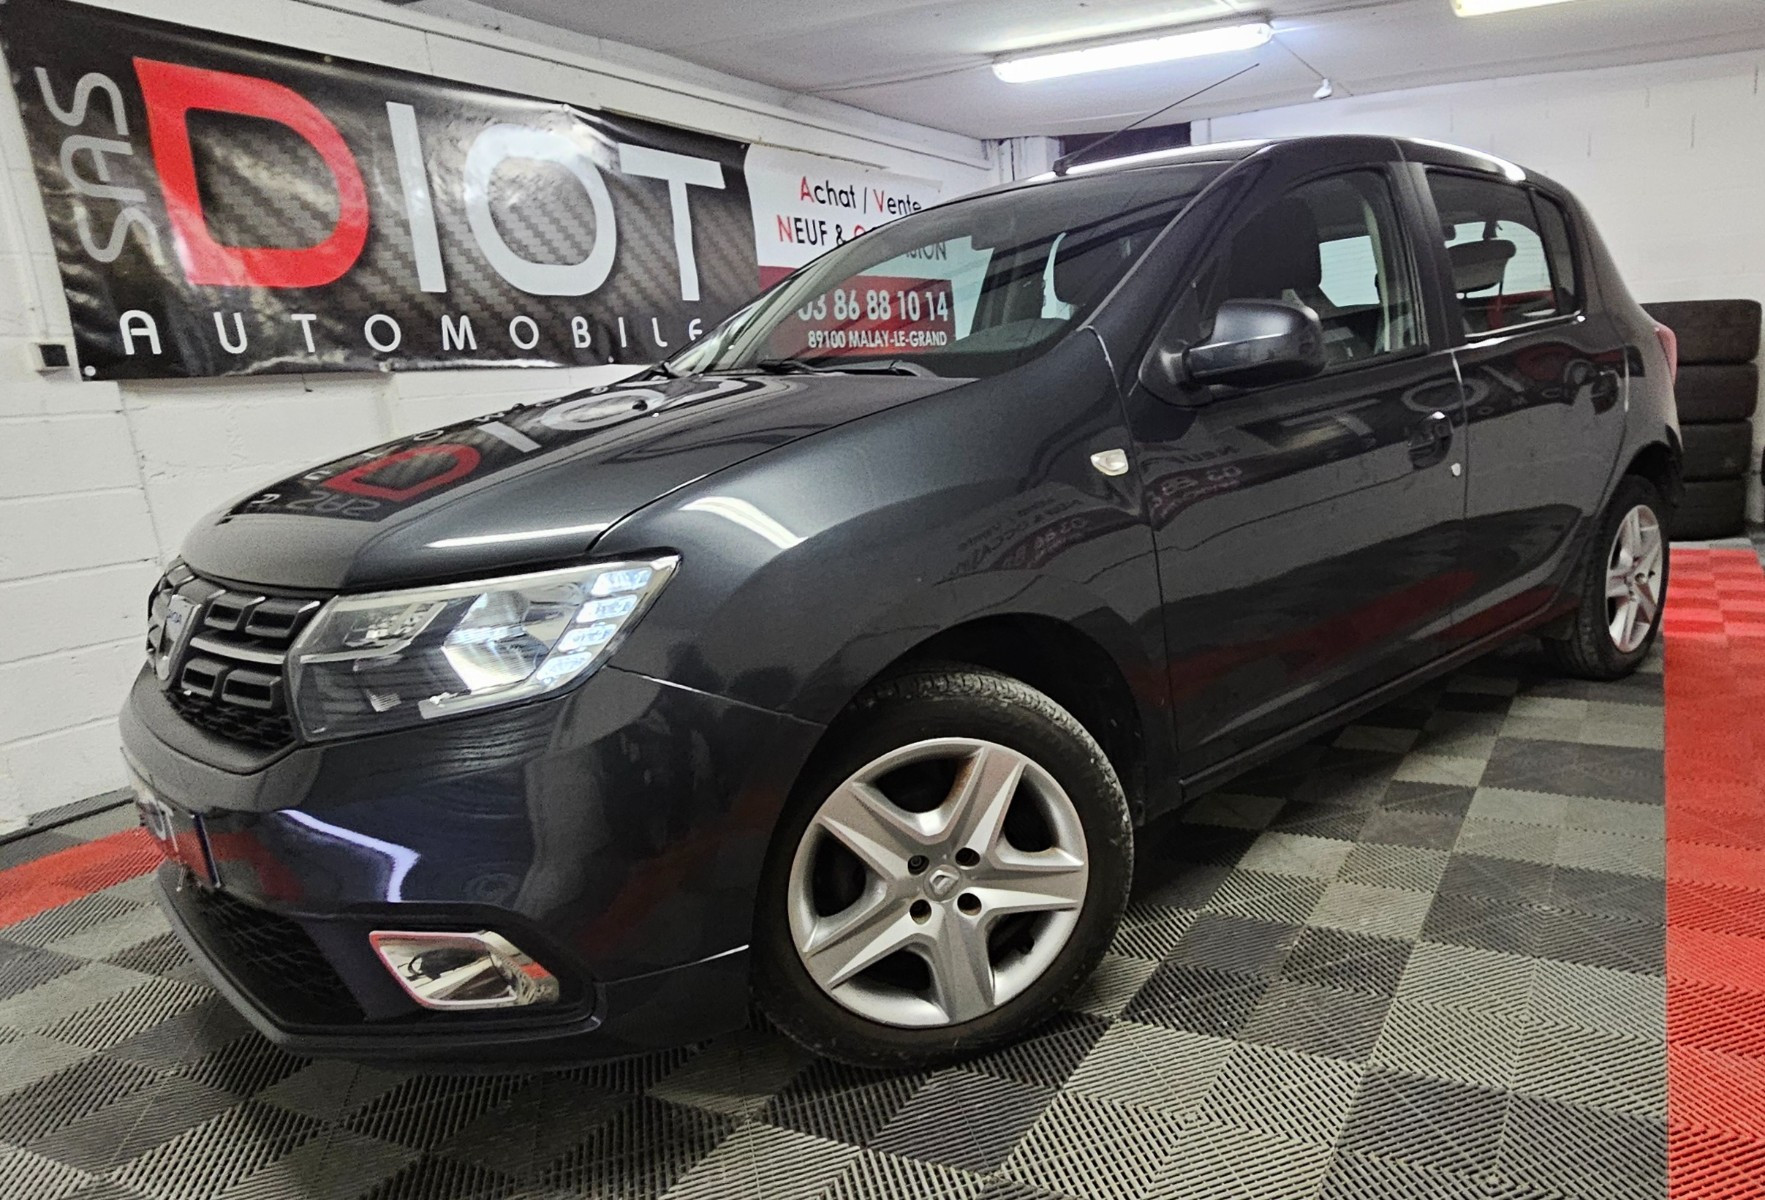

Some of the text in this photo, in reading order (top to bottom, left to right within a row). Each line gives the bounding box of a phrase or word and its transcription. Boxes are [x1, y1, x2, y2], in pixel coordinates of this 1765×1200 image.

[34, 66, 165, 266] SAS
[132, 56, 726, 301] DIOT
[800, 175, 857, 209] Achat
[777, 214, 828, 246] NEUF
[834, 288, 860, 321] 86
[866, 289, 892, 321] 88
[897, 290, 921, 321] 10
[925, 290, 948, 322] 14
[808, 330, 947, 349] 89100 MALAY-LE-GRAND
